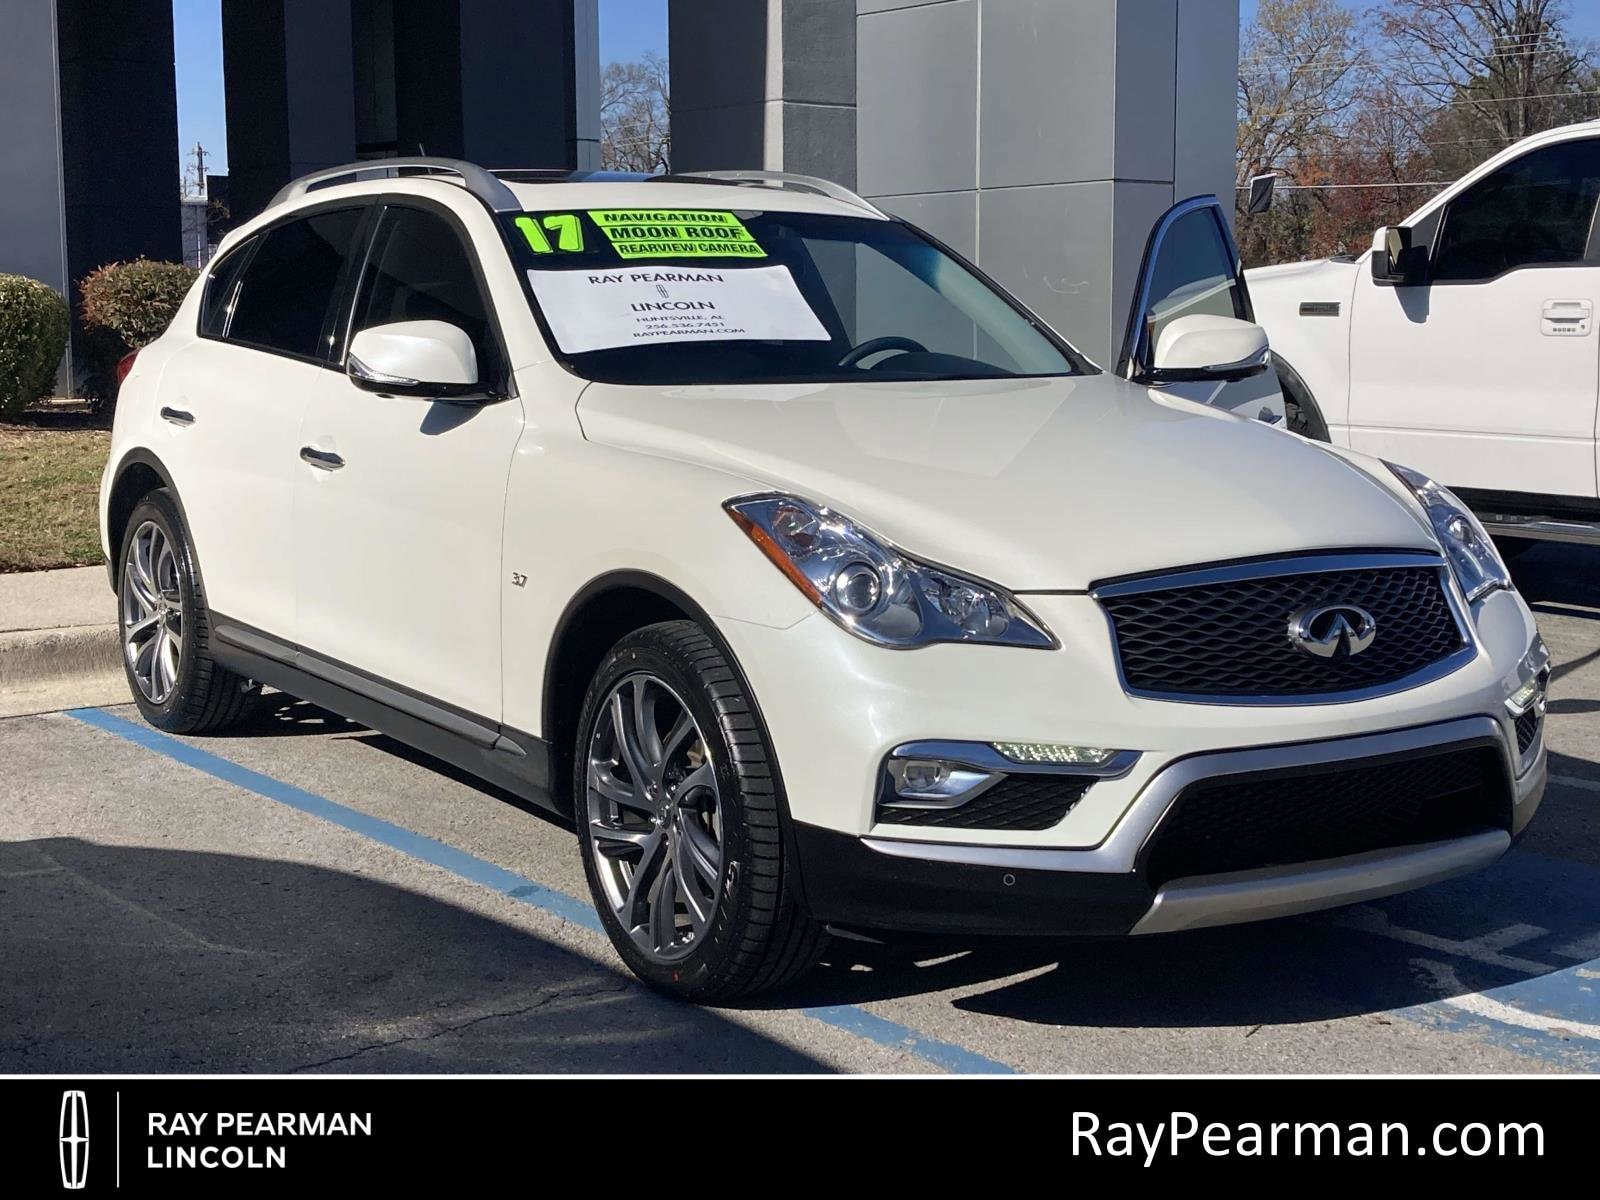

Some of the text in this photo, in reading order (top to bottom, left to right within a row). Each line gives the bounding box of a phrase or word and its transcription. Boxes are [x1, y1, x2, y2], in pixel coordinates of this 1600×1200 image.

[603, 212, 727, 224] NAVIGATION
[515, 214, 584, 254] 17
[611, 226, 744, 240] MOON ROOF
[620, 242, 759, 254] REARVIEW CAMERA
[588, 273, 725, 284] RAY PEARMAN
[630, 301, 716, 312] LINCOLN
[633, 328, 746, 338] RAYPEARMAN.COM
